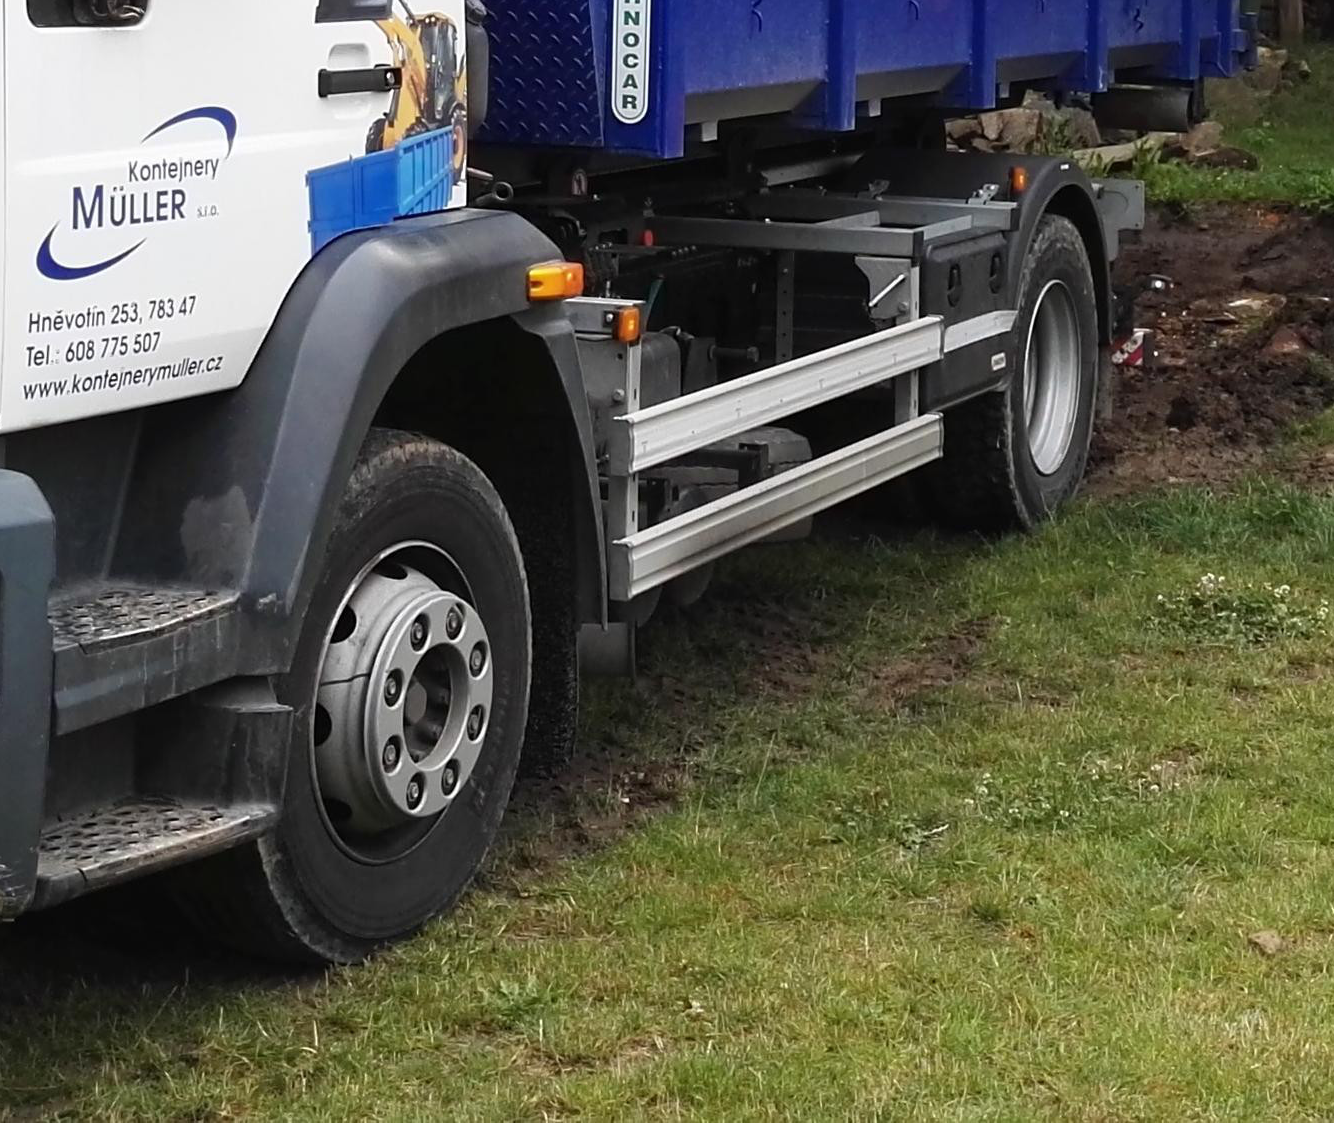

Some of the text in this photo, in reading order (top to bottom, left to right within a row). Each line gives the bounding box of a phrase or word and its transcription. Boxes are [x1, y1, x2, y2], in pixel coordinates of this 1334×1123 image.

[128, 157, 219, 183] Kontejnery
[72, 184, 186, 230] MÜLLER
[28, 296, 197, 334] Hněvotín 253, 783 47
[26, 331, 161, 367] Tel.: 608 775 507
[23, 356, 223, 400] www.kontejnerymuller.cz
